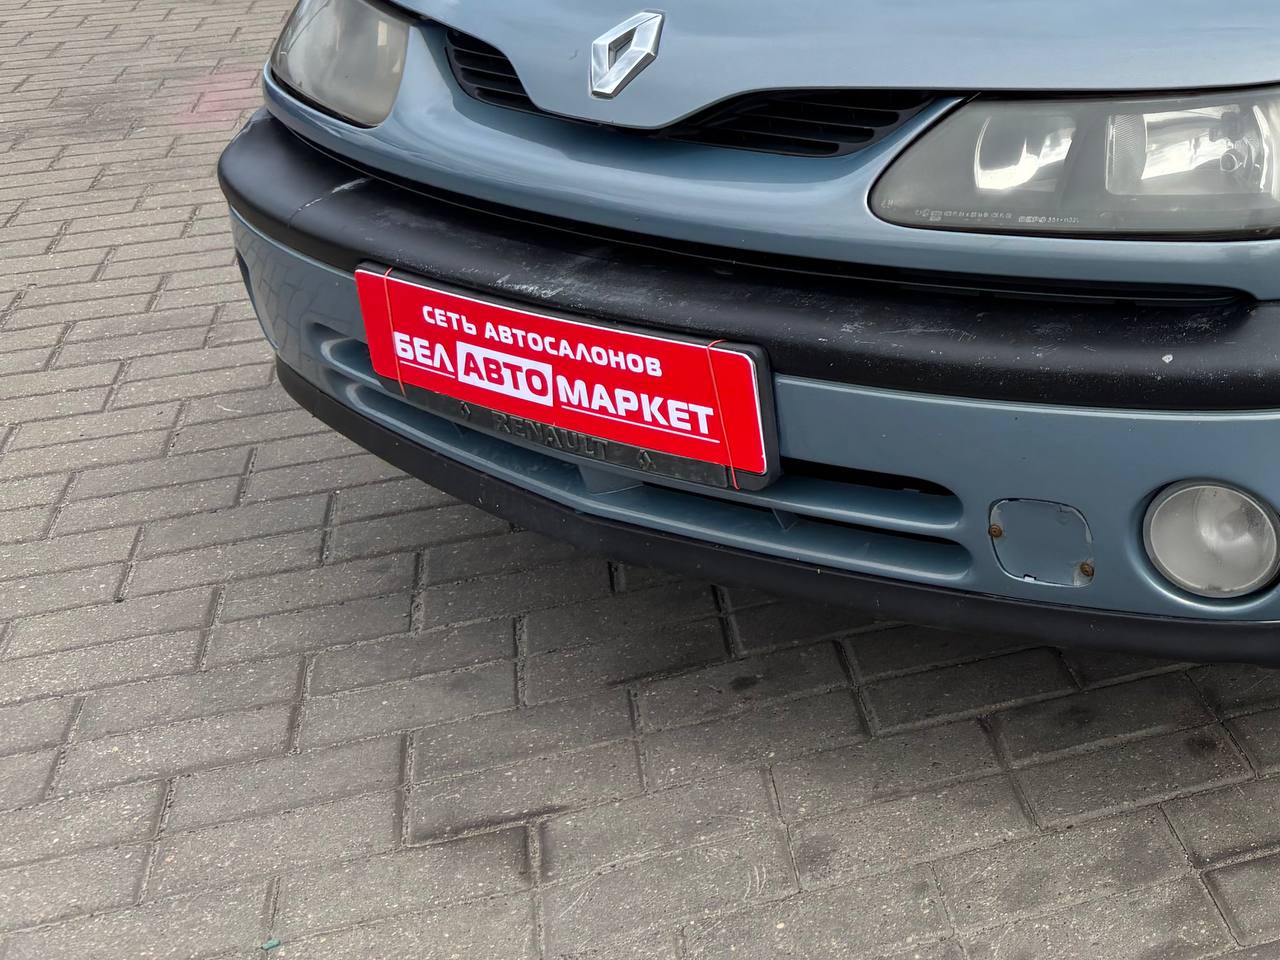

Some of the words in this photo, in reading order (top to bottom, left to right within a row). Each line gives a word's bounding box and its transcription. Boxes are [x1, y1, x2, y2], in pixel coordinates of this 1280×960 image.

[422, 305, 477, 336] СЕТЬ
[484, 321, 663, 377] АВТОСАЛОНОВ
[491, 410, 608, 460] RENAULT
